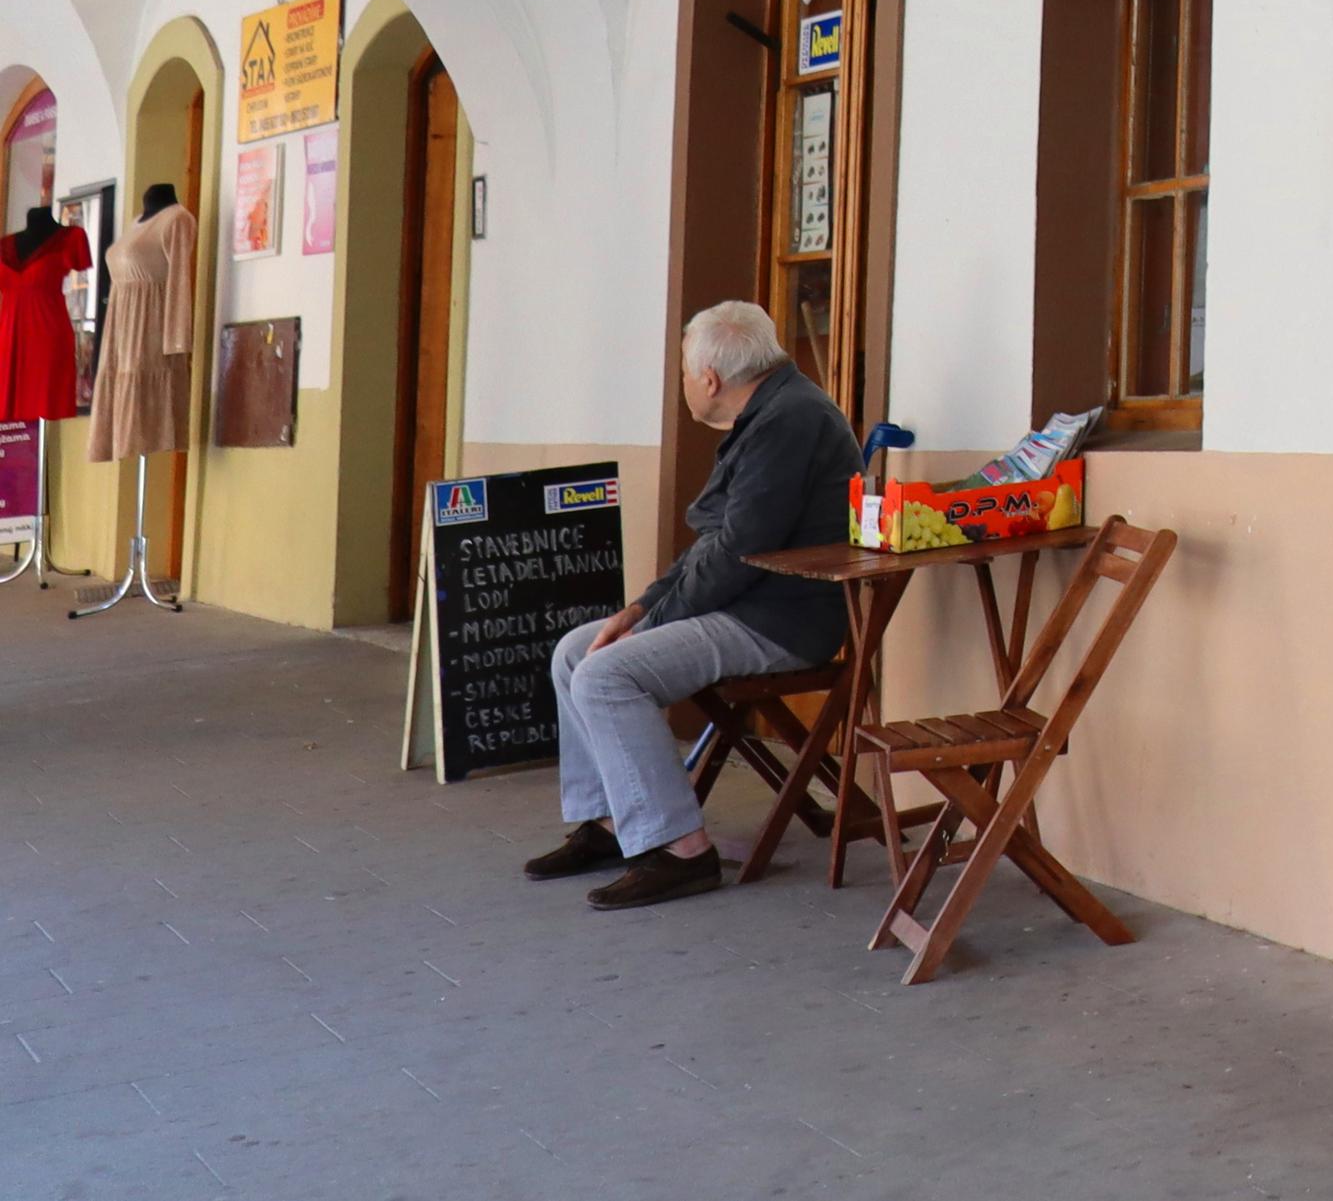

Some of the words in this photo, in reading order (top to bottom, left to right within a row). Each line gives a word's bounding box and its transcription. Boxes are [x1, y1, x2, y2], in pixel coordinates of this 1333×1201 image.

[241, 56, 276, 91] STAX
[563, 486, 604, 505] Revell
[949, 491, 1040, 521] D.P.M.
[460, 524, 585, 563] STAVEBNICE
[467, 723, 558, 753] REPUBLI
